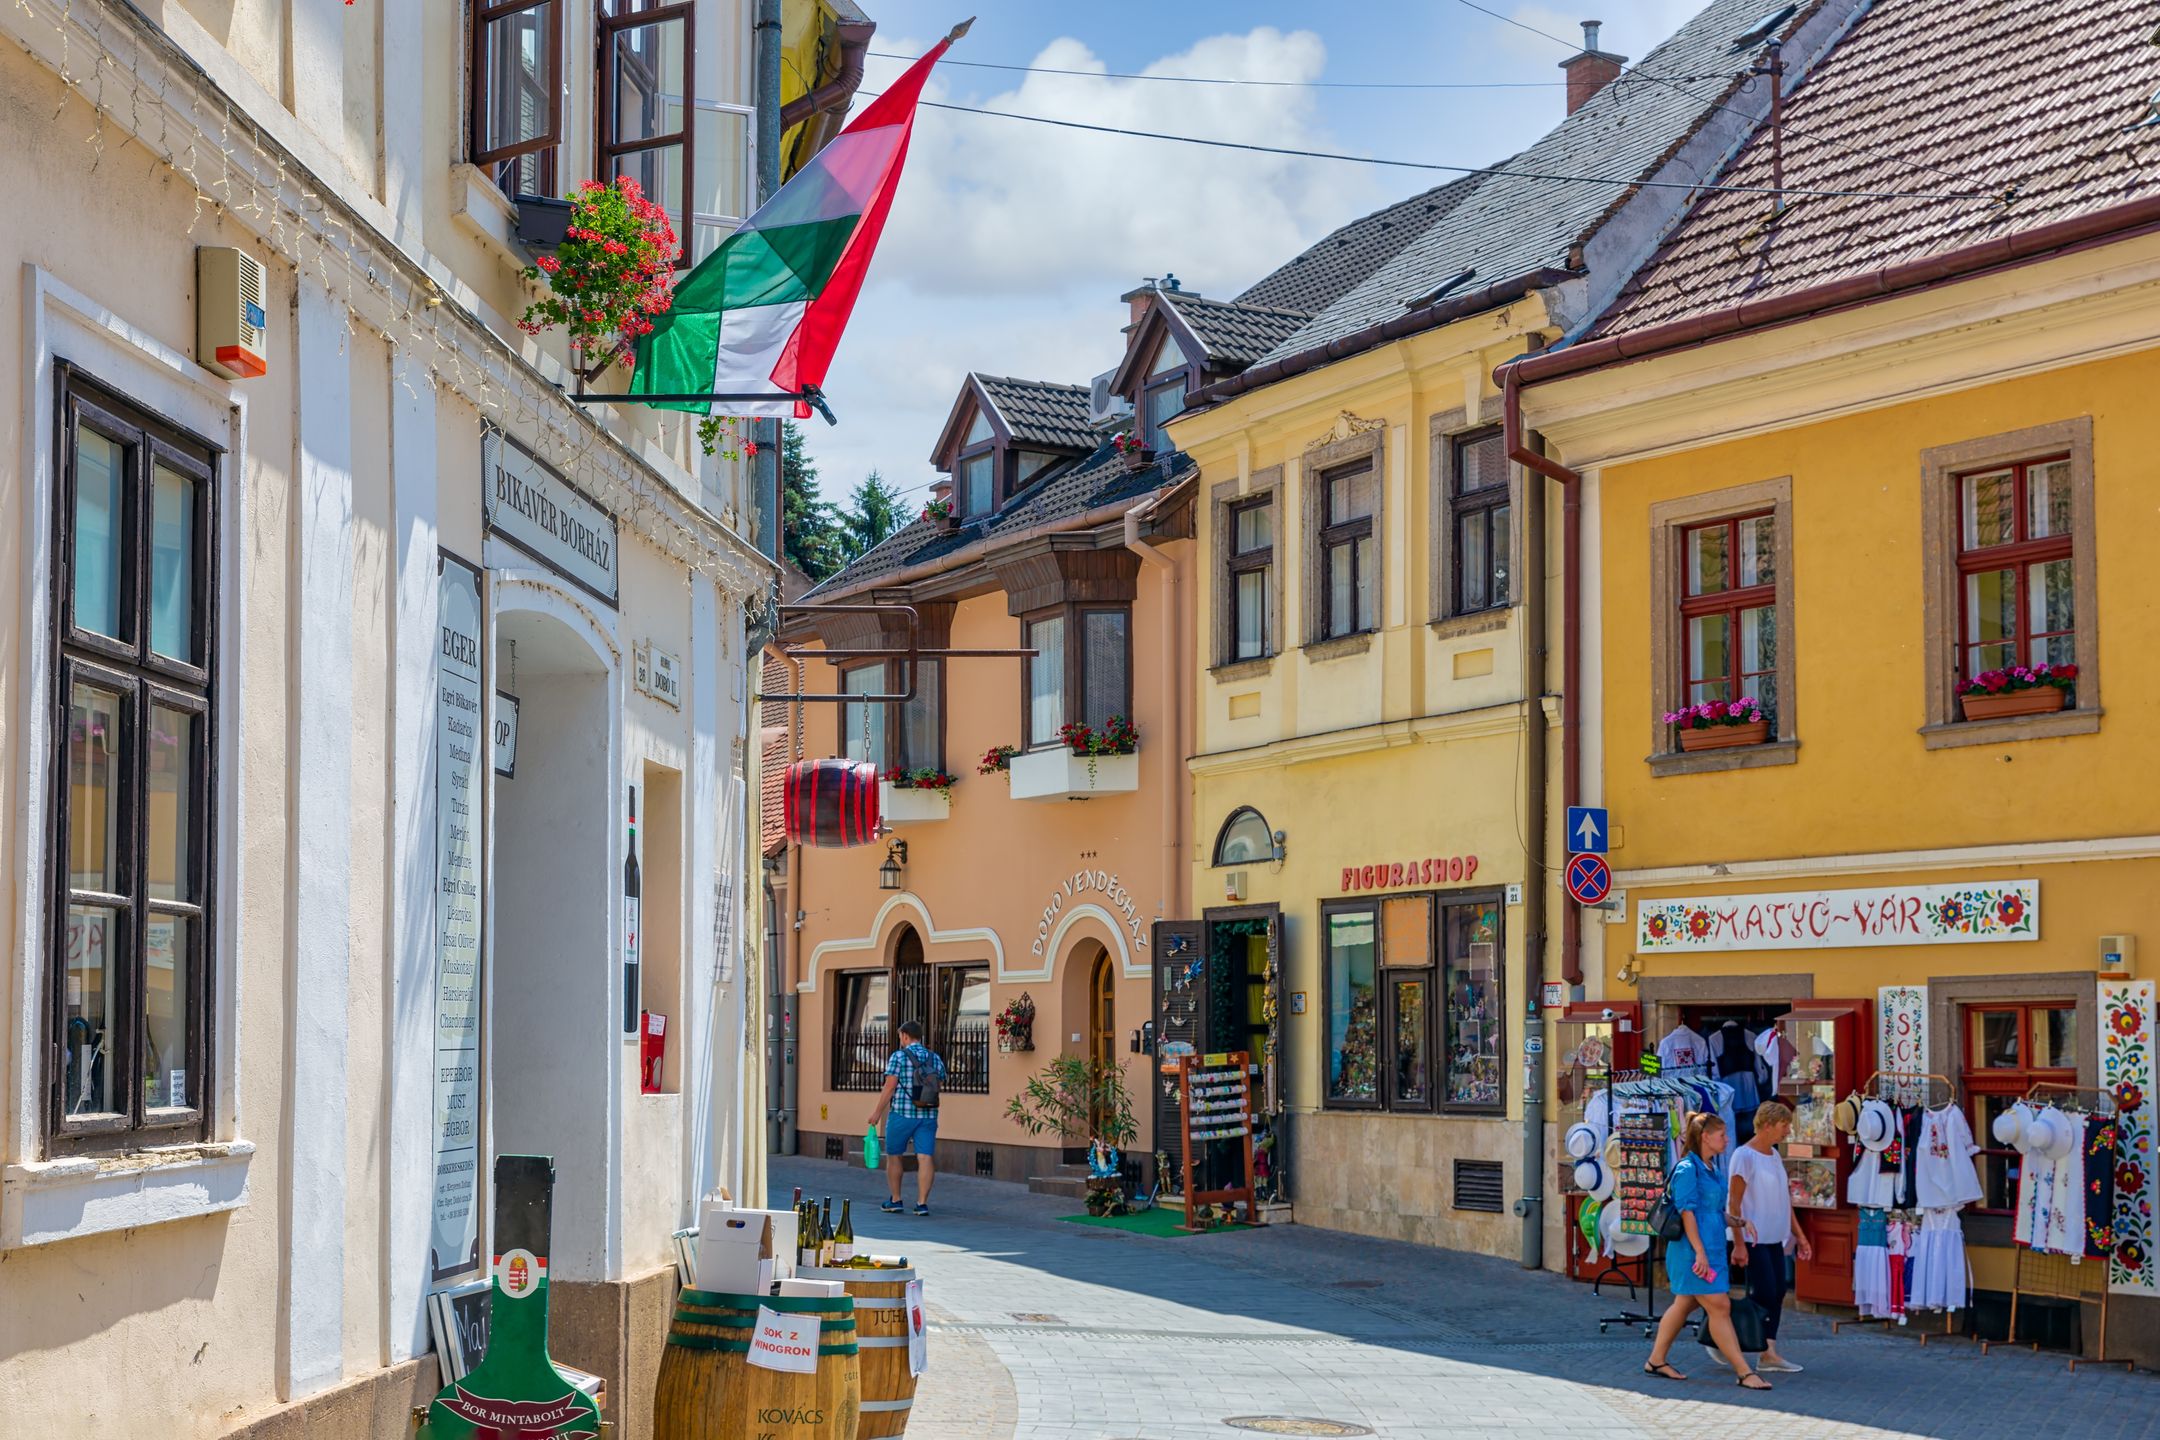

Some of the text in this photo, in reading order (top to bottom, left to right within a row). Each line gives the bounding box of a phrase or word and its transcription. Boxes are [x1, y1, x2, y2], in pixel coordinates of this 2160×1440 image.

[495, 464, 610, 572] BIKAVÉR BORHÁZ
[442, 626, 477, 668] EGER
[655, 671, 671, 693] DOBÓ
[442, 687, 478, 714] Egri Bikavér
[447, 715, 473, 738] Kadarka
[1341, 855, 1478, 892] FIGURASHOP
[1031, 868, 1148, 957] DOBÓ VENDÉGHÁZ
[440, 1066, 473, 1083] EPERBOR
[447, 1093, 467, 1110] MUST
[764, 1327, 799, 1340] SOK Z
[755, 1338, 811, 1356] WINOGRON
[461, 1401, 566, 1425] BOR MINTABOLT
[758, 1406, 824, 1425] KOVÁCS
